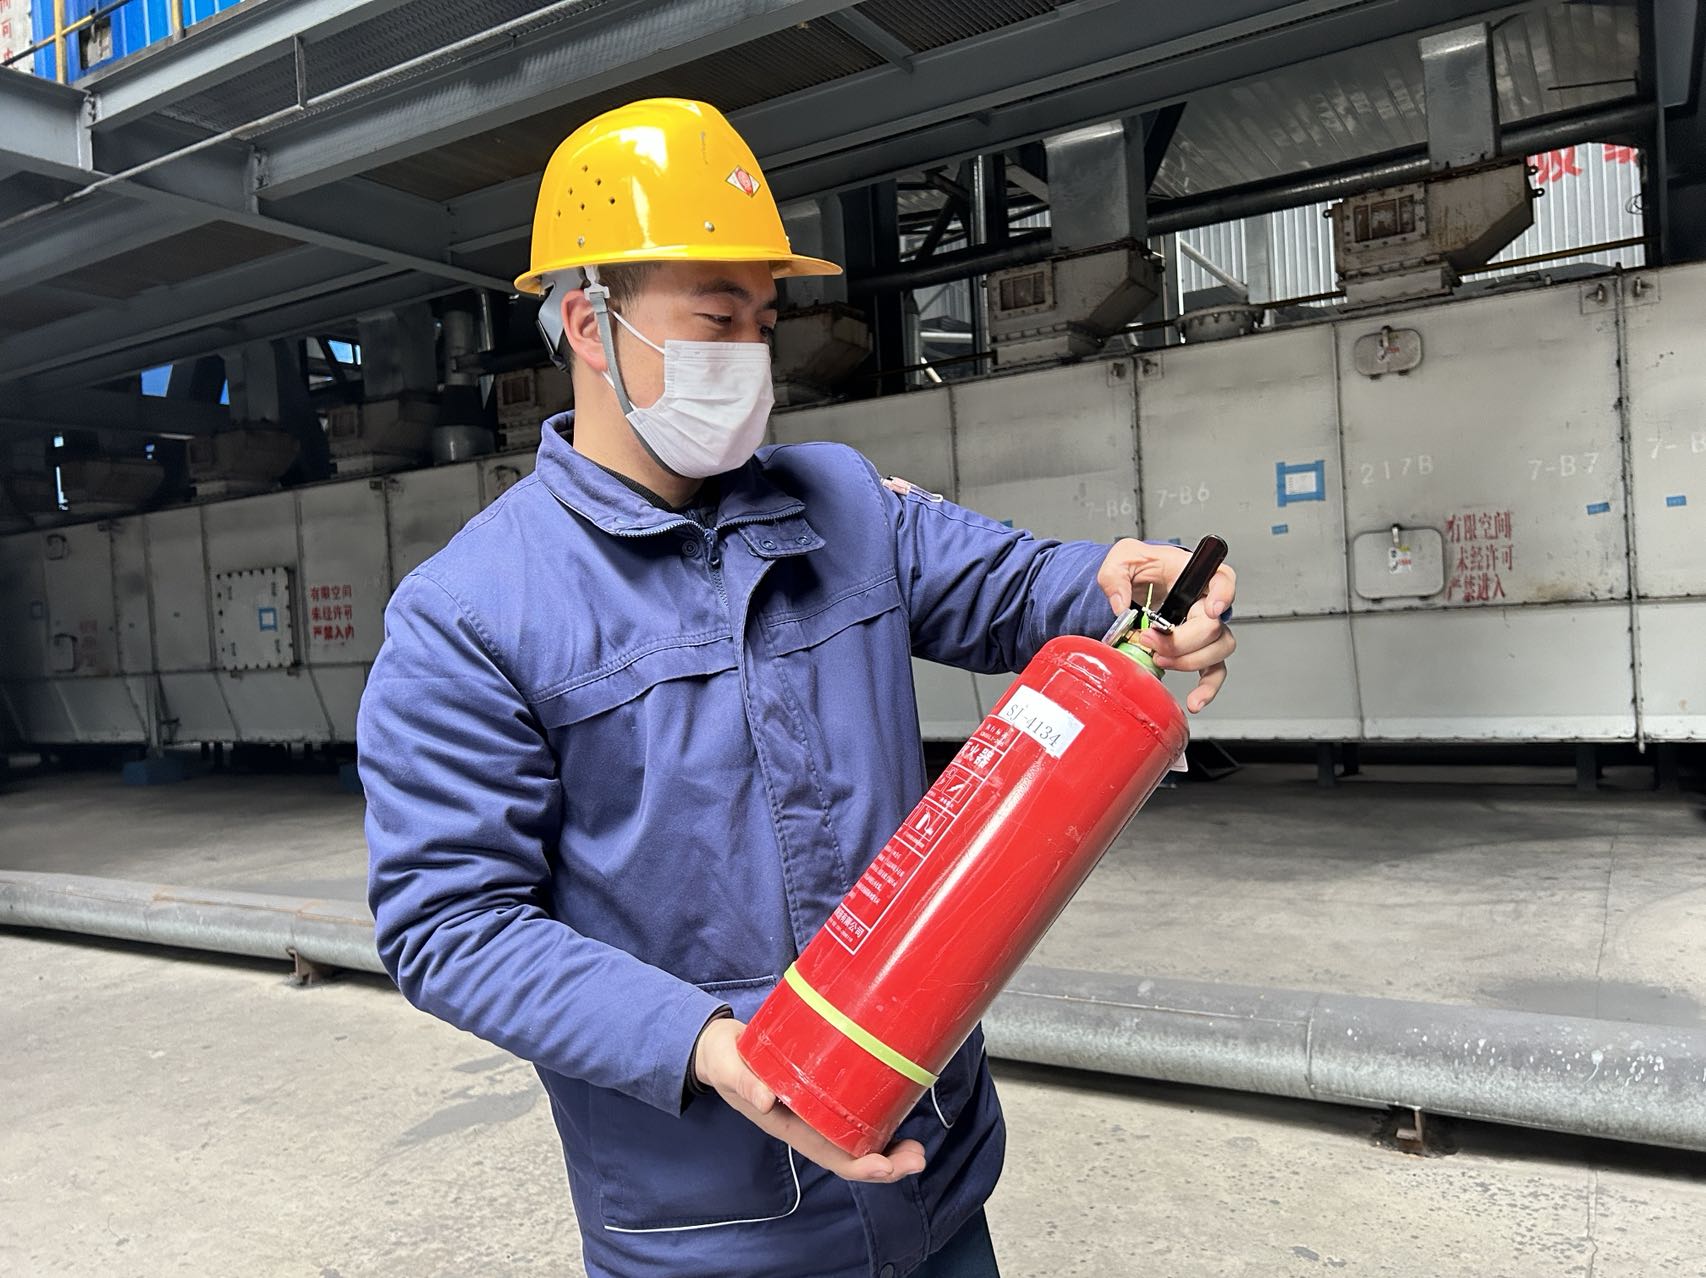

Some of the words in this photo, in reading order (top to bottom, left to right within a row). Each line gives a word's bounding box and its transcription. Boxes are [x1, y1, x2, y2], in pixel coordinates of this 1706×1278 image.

[1360, 455, 1434, 485] 217B
[1527, 452, 1600, 480] 7-B7
[1156, 483, 1210, 508] 7-B6
[1446, 511, 1512, 543] 有限空间
[1457, 543, 1514, 574] 未经许可
[311, 584, 352, 602] 有限空间
[1444, 572, 1506, 602] 严禁进入
[312, 623, 355, 641] 严禁入内
[1006, 703, 1062, 748] SJ-4134
